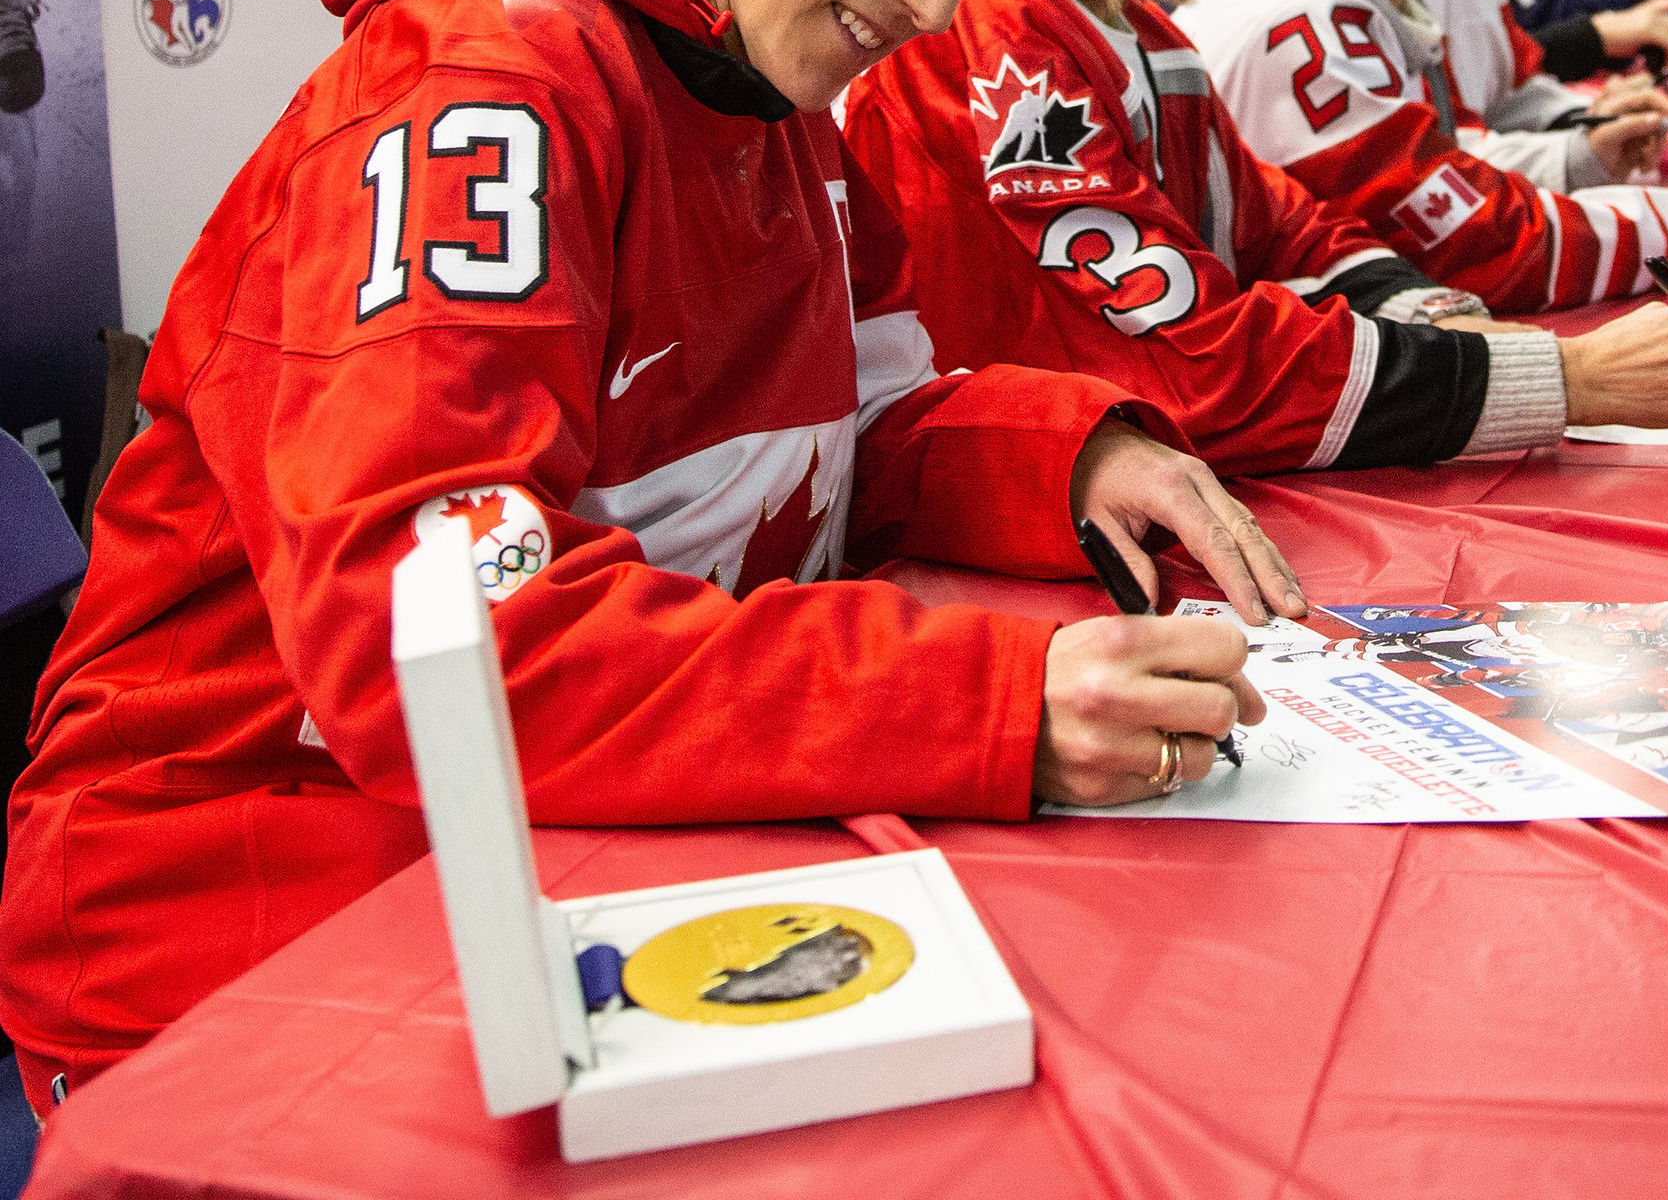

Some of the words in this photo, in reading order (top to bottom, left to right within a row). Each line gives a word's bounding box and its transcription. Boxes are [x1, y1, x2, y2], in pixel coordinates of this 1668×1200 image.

[1266, 2, 1405, 134] 29
[355, 100, 549, 326] 13
[988, 175, 1112, 202] ANADA
[1036, 203, 1199, 338] 3
[1263, 687, 1372, 743] CAROLINE
[1358, 743, 1499, 818] OUELLETTE
[1319, 695, 1401, 737] HOCKEY
